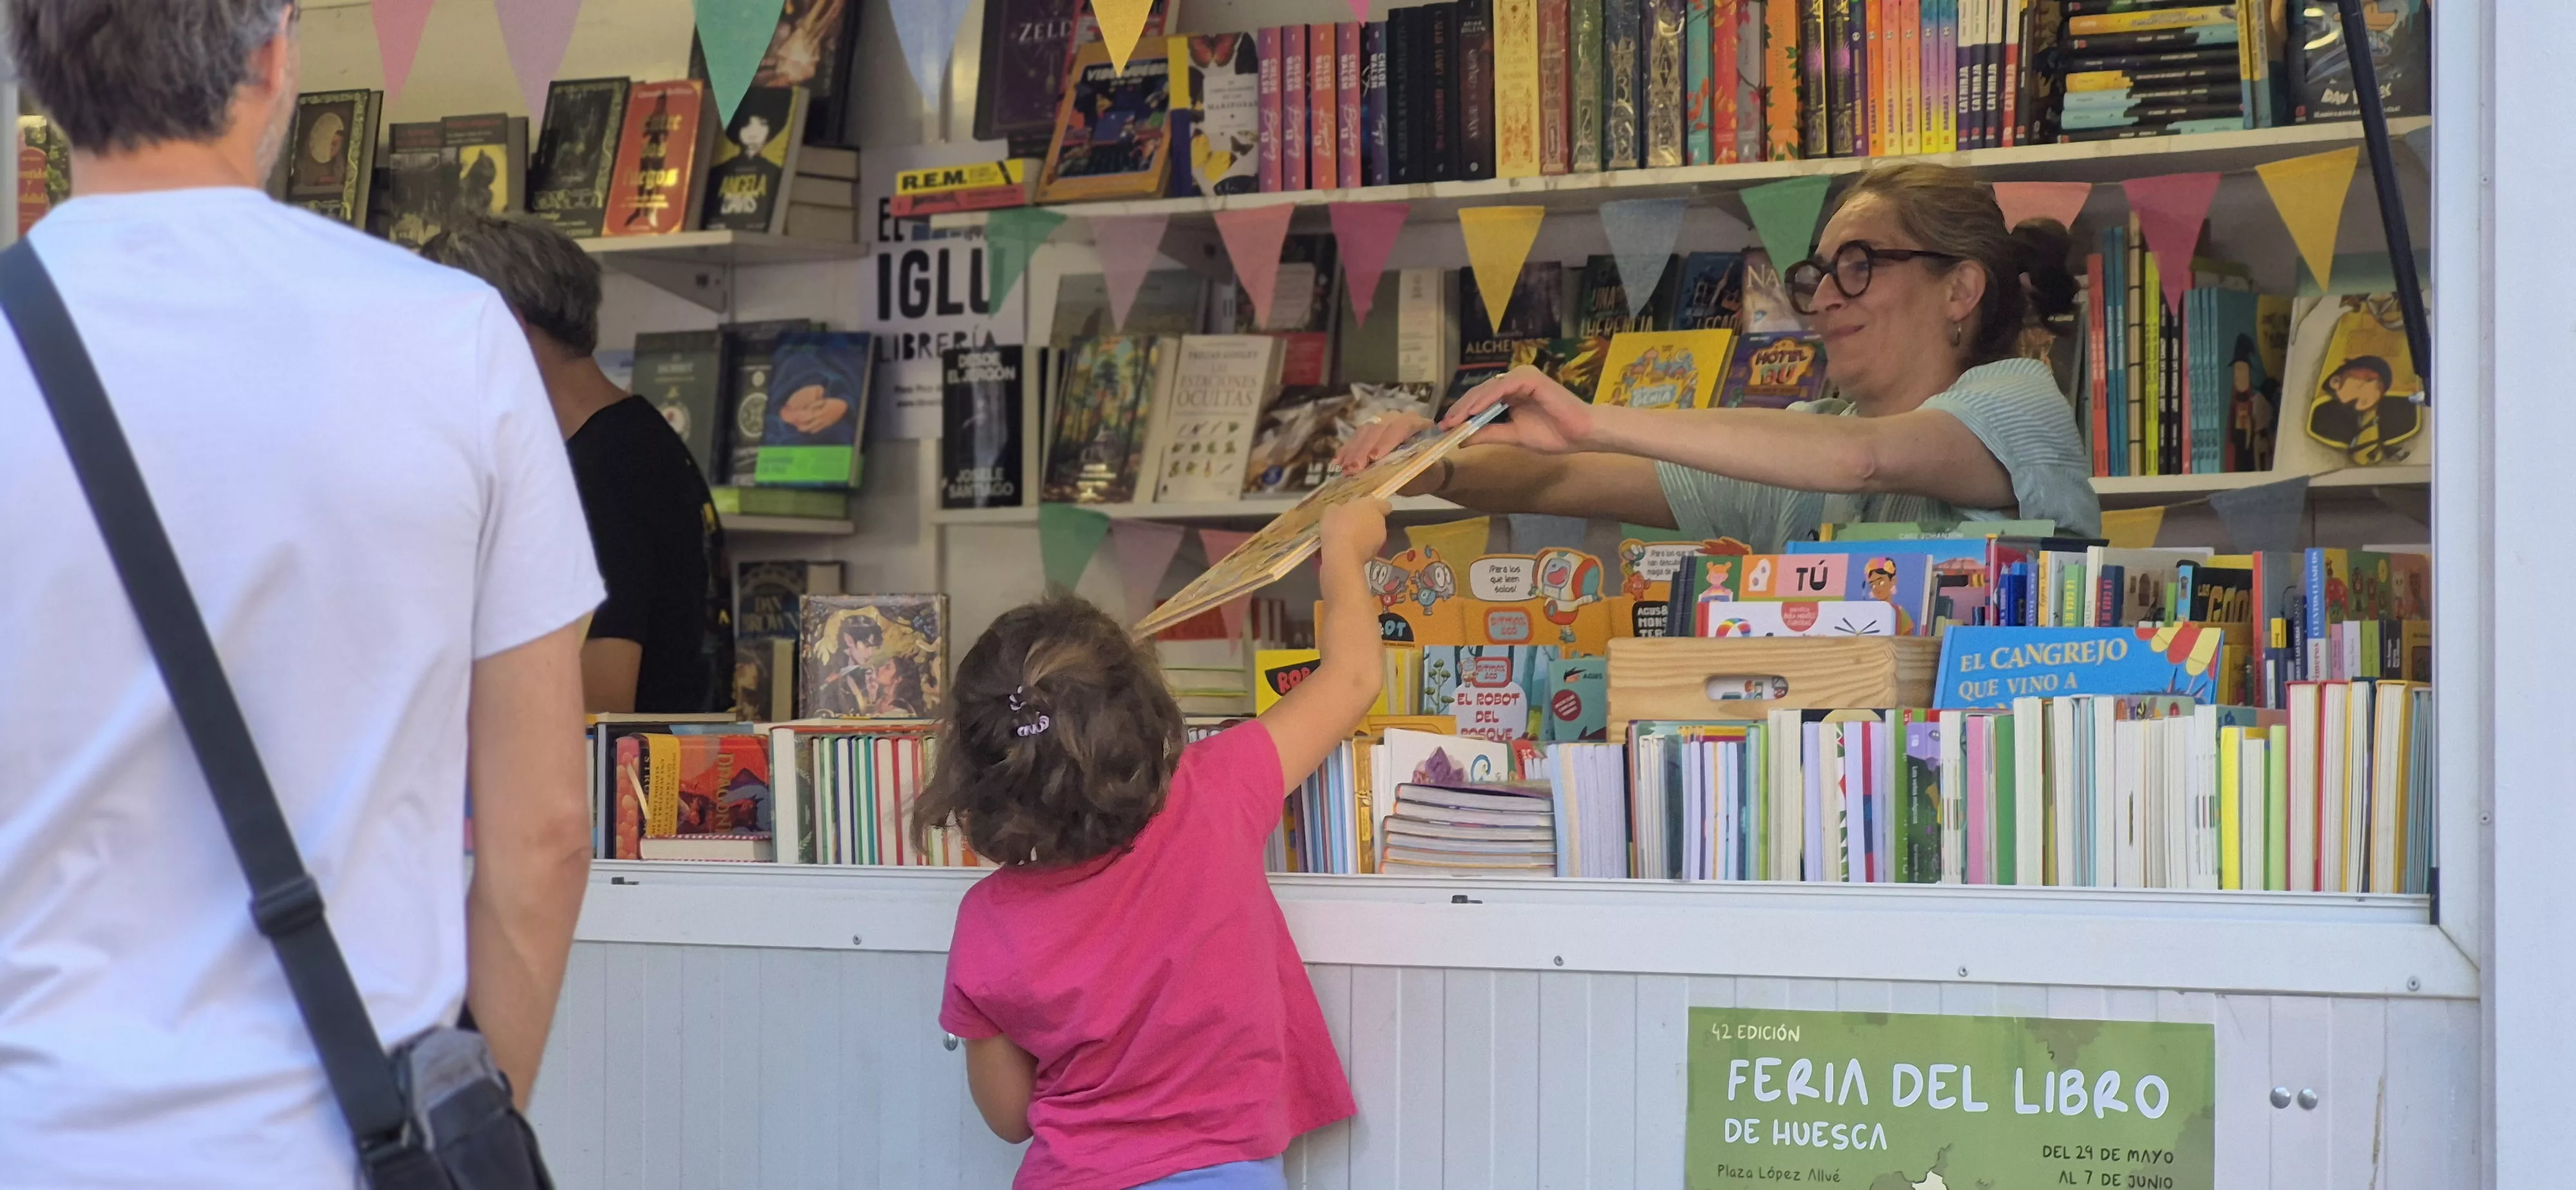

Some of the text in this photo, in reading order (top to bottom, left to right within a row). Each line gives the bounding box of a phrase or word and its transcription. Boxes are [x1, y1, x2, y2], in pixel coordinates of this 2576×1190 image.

[902, 170, 967, 190] R.E.M.
[875, 325, 998, 364] LIBRERÍA
[1466, 339, 1513, 354] ALCHE
[1755, 350, 1808, 366] HOTEL
[1177, 390, 1255, 407] OCULTAS
[1795, 559, 1828, 592] TÚ
[755, 596, 782, 612] DAN
[741, 612, 800, 632] BROWN
[1960, 637, 2129, 673] EL CANGREJO
[1958, 672, 2078, 702] QUE VINO A
[1457, 692, 1520, 706] EL ROBOT
[1475, 710, 1499, 723] DEL
[1712, 1023, 1800, 1042] 42 EDICIÓN
[1728, 1057, 2169, 1119] FERIA DEL LIBRO
[1725, 1118, 1888, 1150] DE HUESCA
[2043, 1145, 2174, 1164] DEL 29 DE MAYO
[1718, 1164, 1753, 1179] Plaza
[1759, 1166, 1801, 1182] López
[2059, 1170, 2173, 1189] AL 7 DE JUNIO
